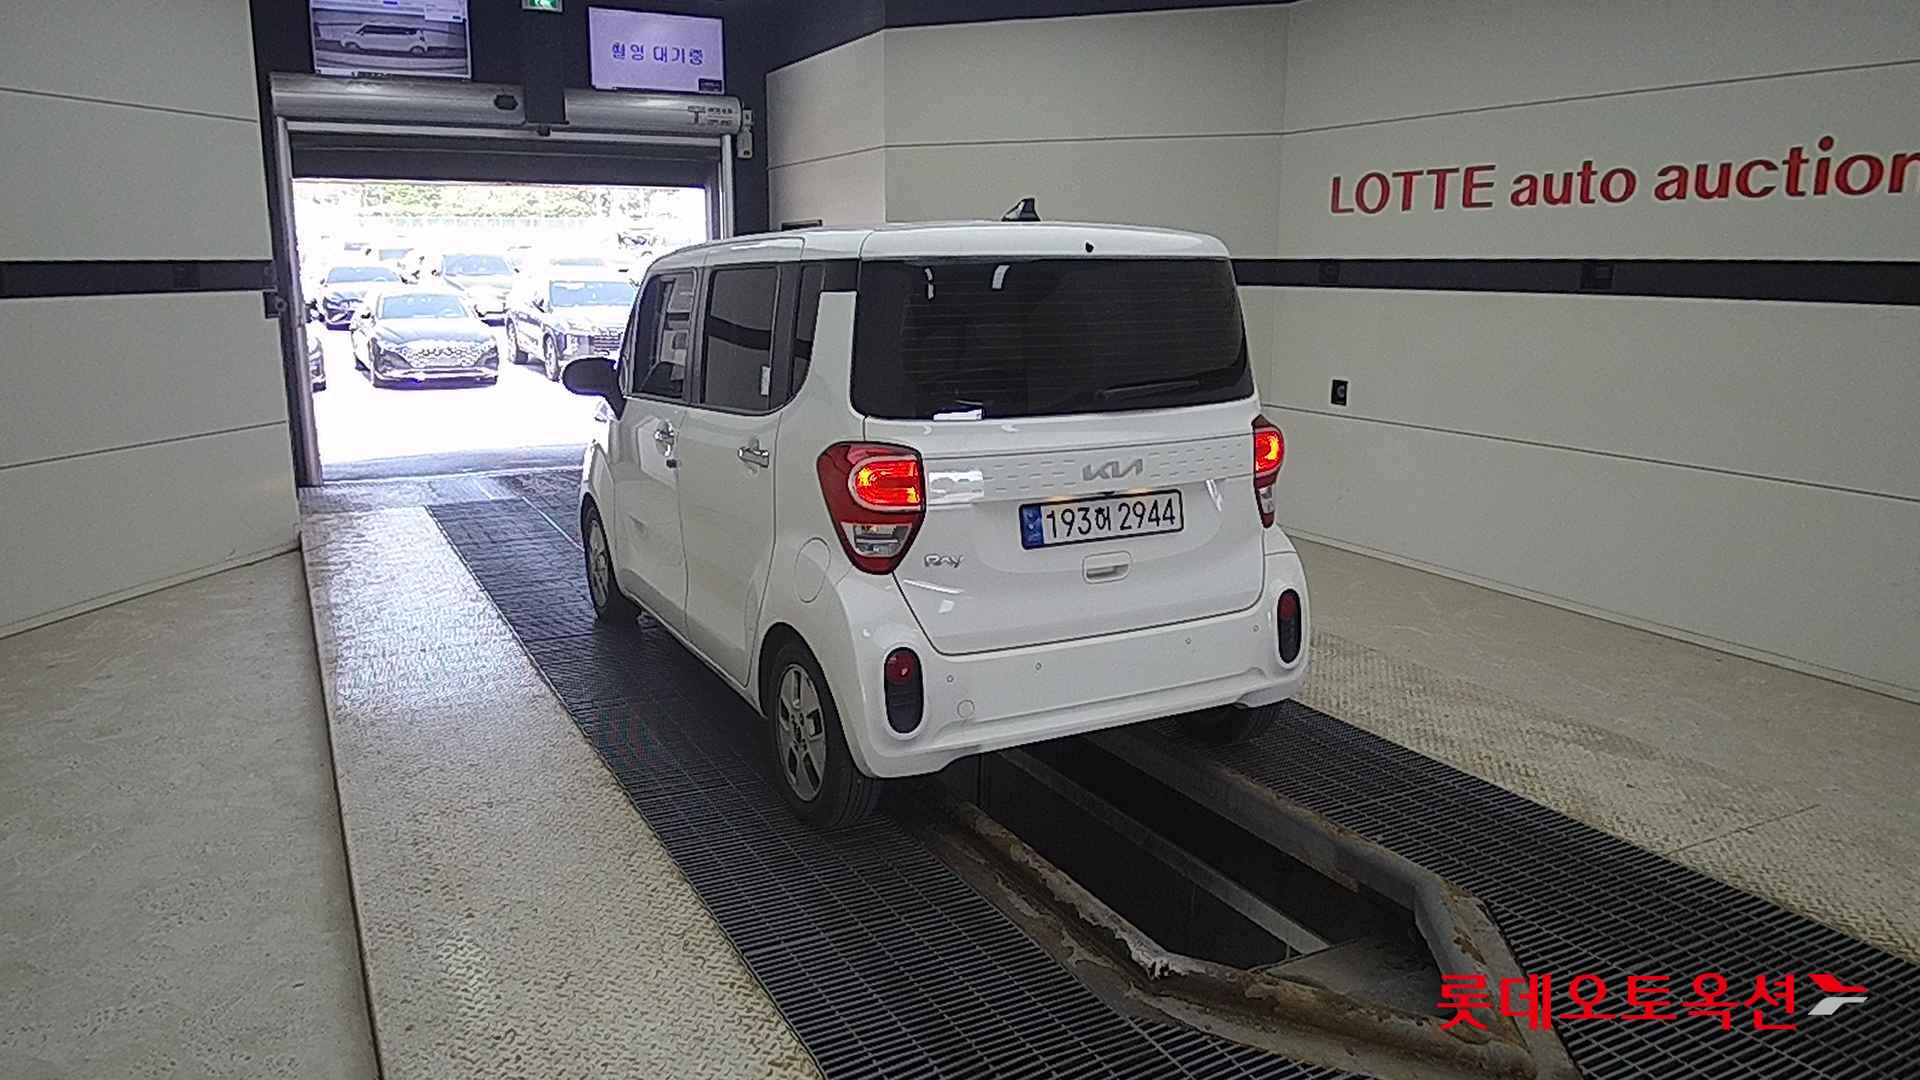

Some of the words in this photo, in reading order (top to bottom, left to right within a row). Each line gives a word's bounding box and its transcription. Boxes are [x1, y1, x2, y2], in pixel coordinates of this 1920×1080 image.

[1330, 164, 1497, 215] LOTTE
[1510, 160, 1637, 207] auto
[1082, 458, 1143, 481] KIA
[1118, 497, 1176, 530] 2944
